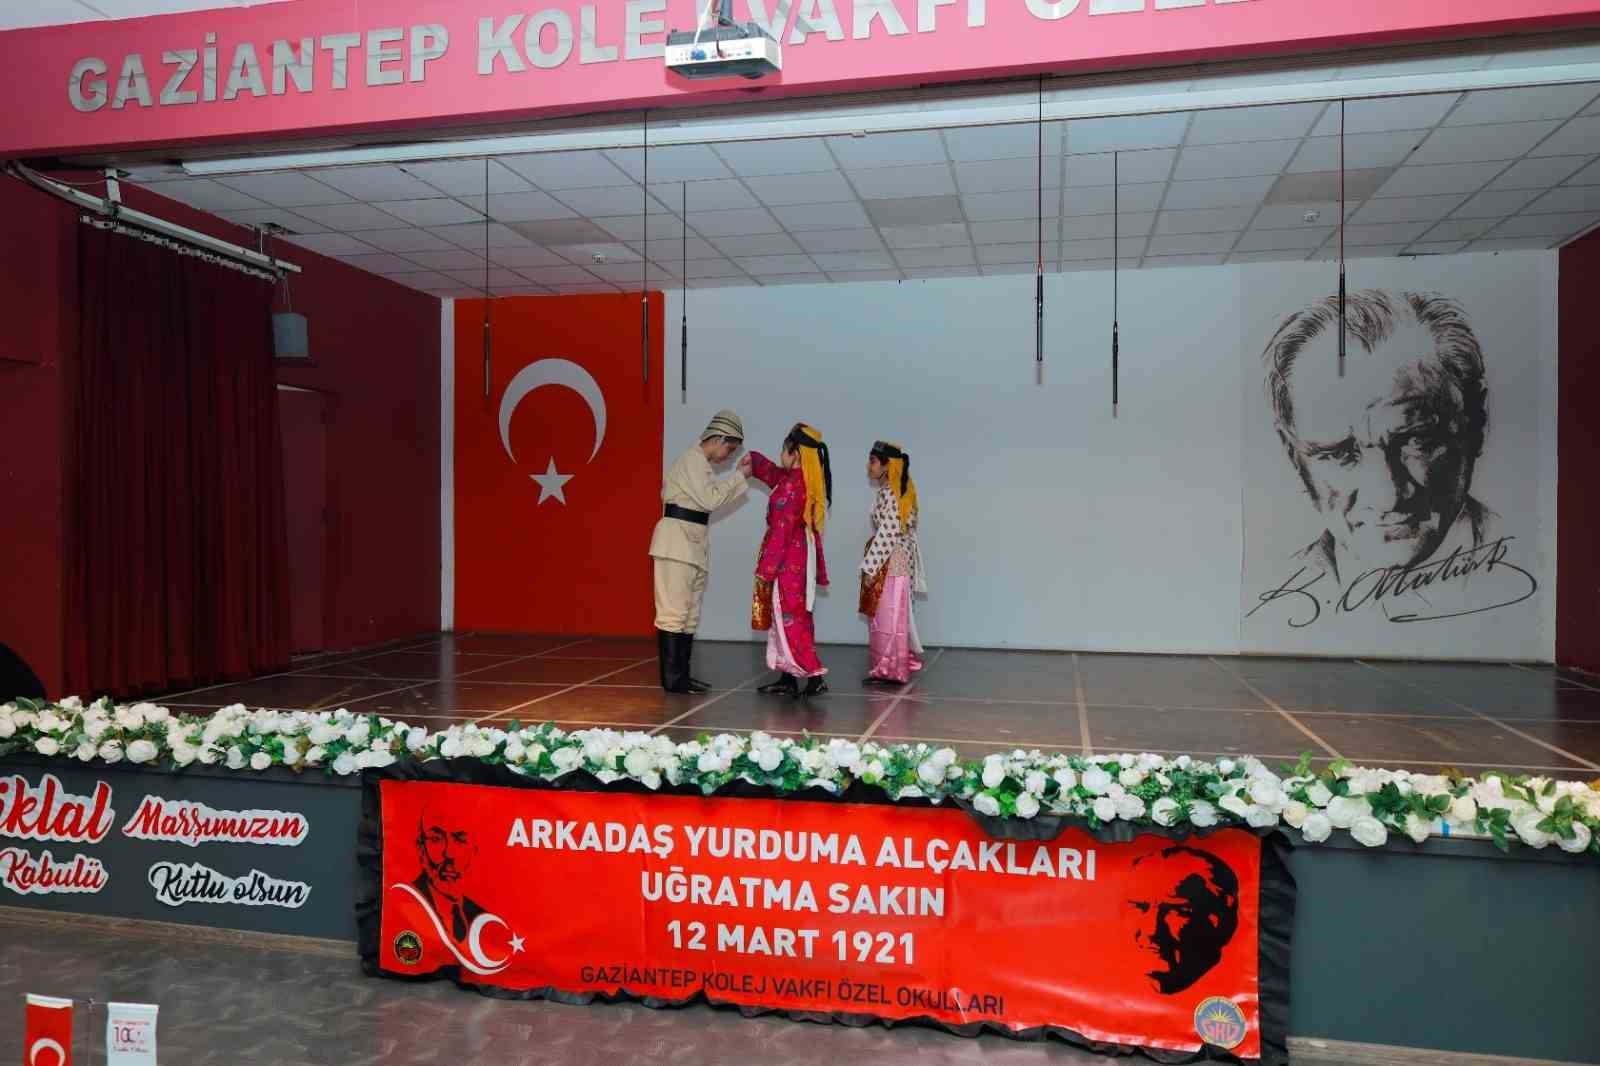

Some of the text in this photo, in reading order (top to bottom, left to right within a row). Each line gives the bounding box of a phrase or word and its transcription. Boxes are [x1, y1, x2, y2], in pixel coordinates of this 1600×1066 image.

[68, 23, 449, 112] GAZİANTEP
[122, 799, 305, 842] Marşımızın
[0, 850, 104, 891] Kabulü
[507, 818, 1097, 882] ARKADAŞ YURDUMA ALÇAKLARI
[150, 865, 307, 904] Kutlu olsun
[640, 866, 946, 918] UĞRATMA SAKIN
[667, 920, 915, 966] 12 MART 1921
[580, 964, 1005, 1016] GAZİANTEP KOLEJ VAKFI ÖZEL OKULLARI
